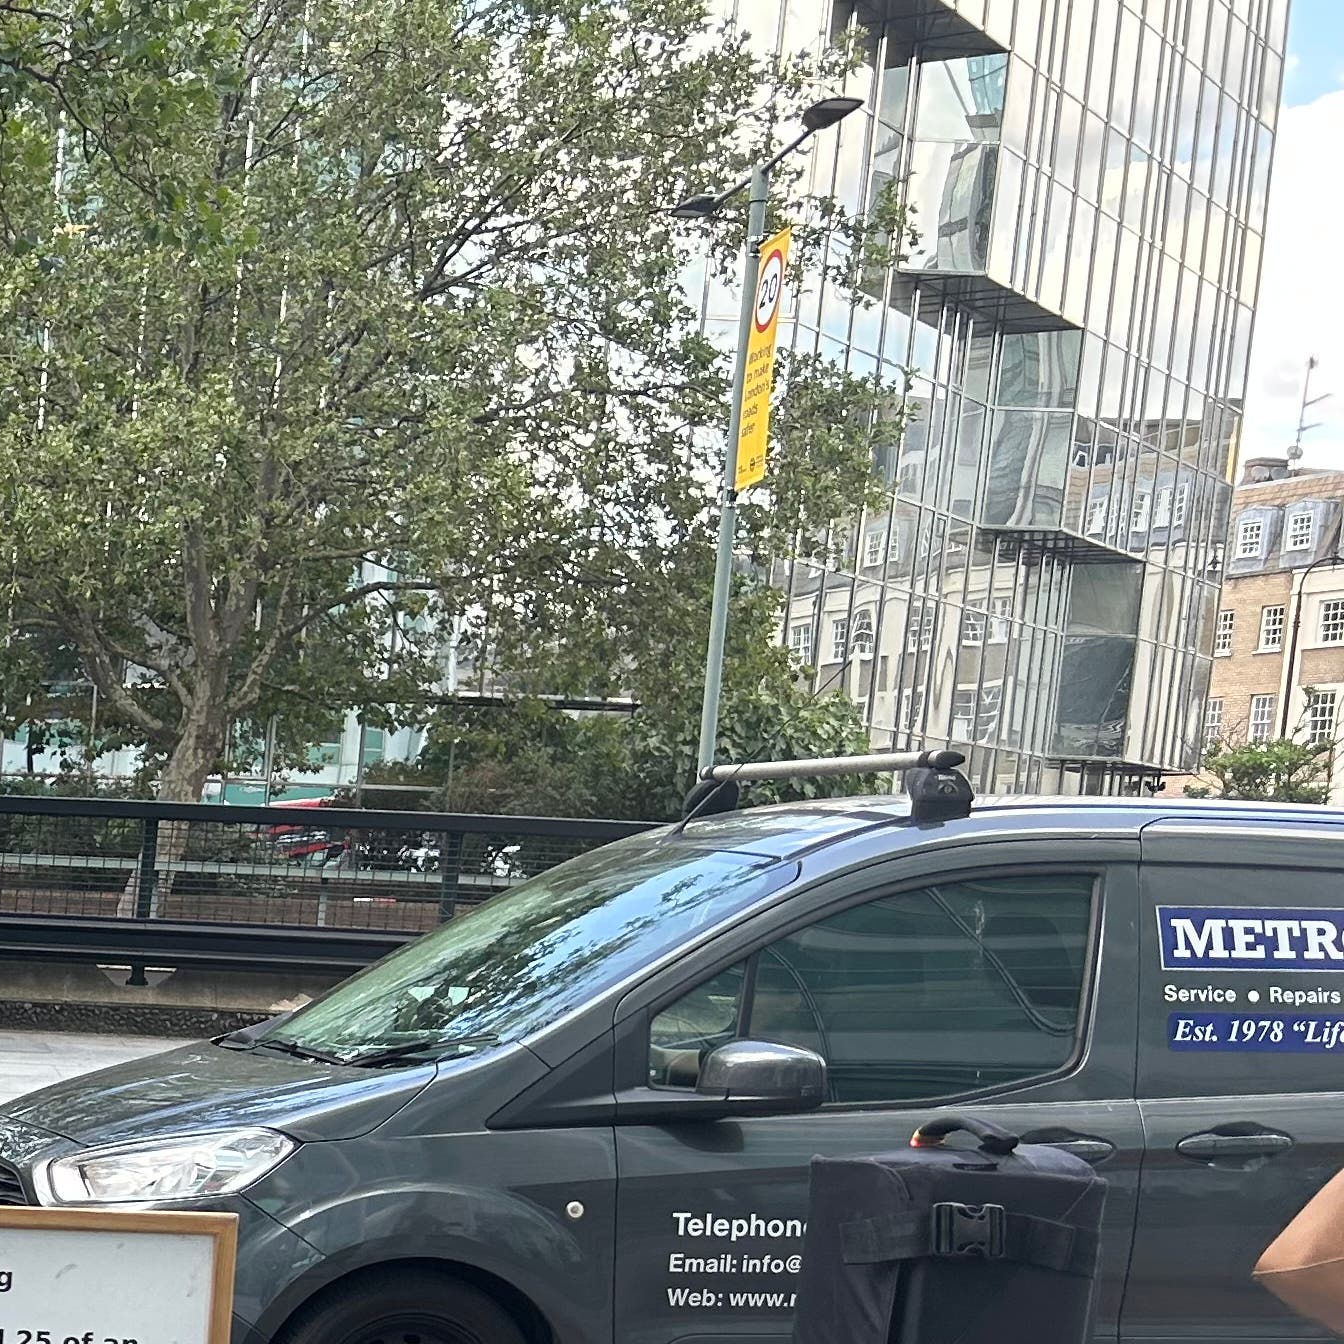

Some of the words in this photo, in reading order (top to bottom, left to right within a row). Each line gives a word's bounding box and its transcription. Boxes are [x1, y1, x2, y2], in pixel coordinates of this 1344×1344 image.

[759, 273, 778, 310] 20
[1170, 918, 1344, 961] METR
[1164, 984, 1237, 1002] Service
[1269, 986, 1342, 1006] Repairs
[1173, 1019, 1219, 1042] Est.
[1227, 1019, 1285, 1042] 1978
[672, 1212, 807, 1241] Telephon
[669, 1253, 738, 1273] Email:
[667, 1288, 723, 1307] Web:
